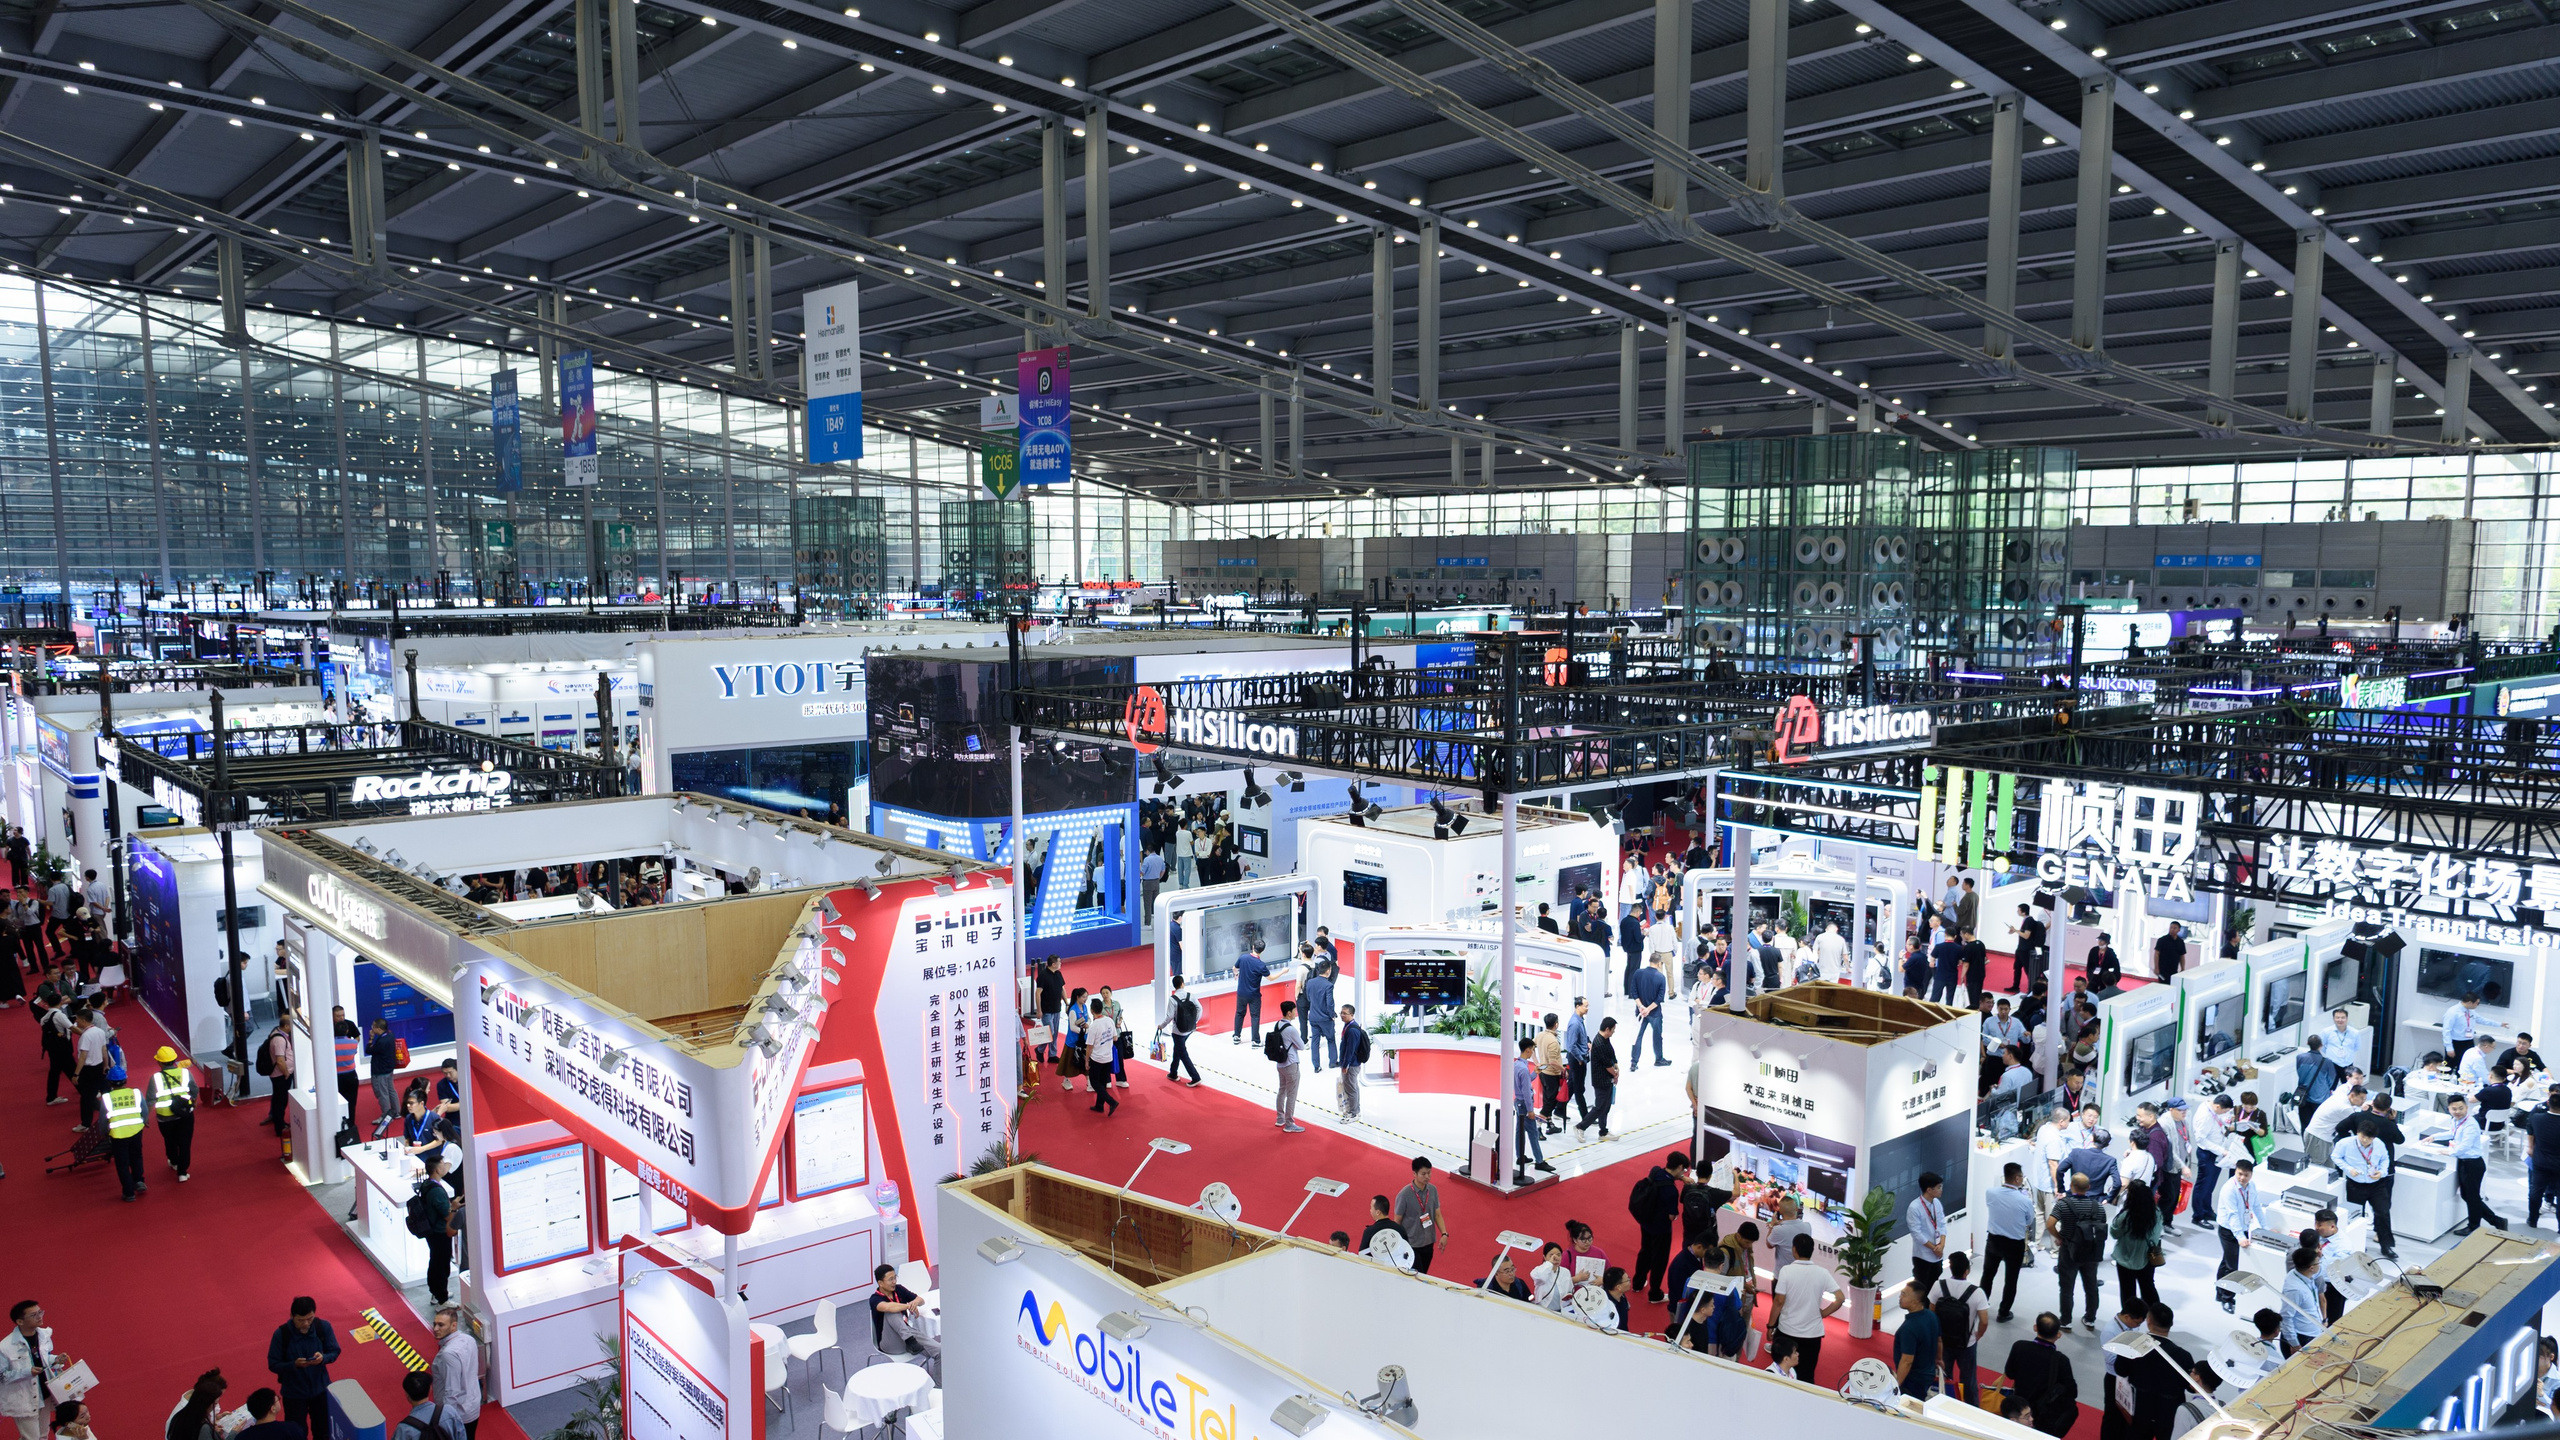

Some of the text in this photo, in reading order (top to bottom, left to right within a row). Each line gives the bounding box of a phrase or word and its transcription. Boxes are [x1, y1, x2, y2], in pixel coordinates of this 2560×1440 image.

[826, 416, 844, 432] 1B49
[1037, 415, 1052, 426] 1C08
[989, 455, 1013, 470] 1C05
[1025, 444, 1065, 456] 无网无电AOV
[1030, 459, 1061, 470] 就选睿博士
[500, 526, 505, 543] 1
[619, 528, 626, 543] 1
[1112, 604, 1130, 615] 1C08
[714, 662, 832, 698] YTOT
[1175, 708, 1296, 755] HiSilicon
[1826, 704, 1929, 746] HiSilicon
[352, 760, 512, 802] Rockchip
[409, 794, 513, 816] 瑞芯微电子
[254, 819, 279, 830] 1A23
[2037, 853, 2196, 903] GENATA
[308, 873, 344, 931] cudy
[2325, 898, 2383, 925] Idea
[915, 926, 1003, 953] 宝讯电子
[481, 1015, 533, 1063] 宝讯电子
[949, 988, 969, 1078] 800人本地女工
[541, 1005, 694, 1119] 阳春宝讯子有限公司
[929, 994, 944, 1145] 完全自主研发生产设备
[978, 986, 993, 1134] 极细同轴生产加工16年
[1749, 1099, 1775, 1112] Welcome
[1818, 1243, 1833, 1255] LED
[1017, 1334, 1050, 1364] Smart
[1056, 1361, 1106, 1399] solution
[1114, 1397, 1131, 1416] for
